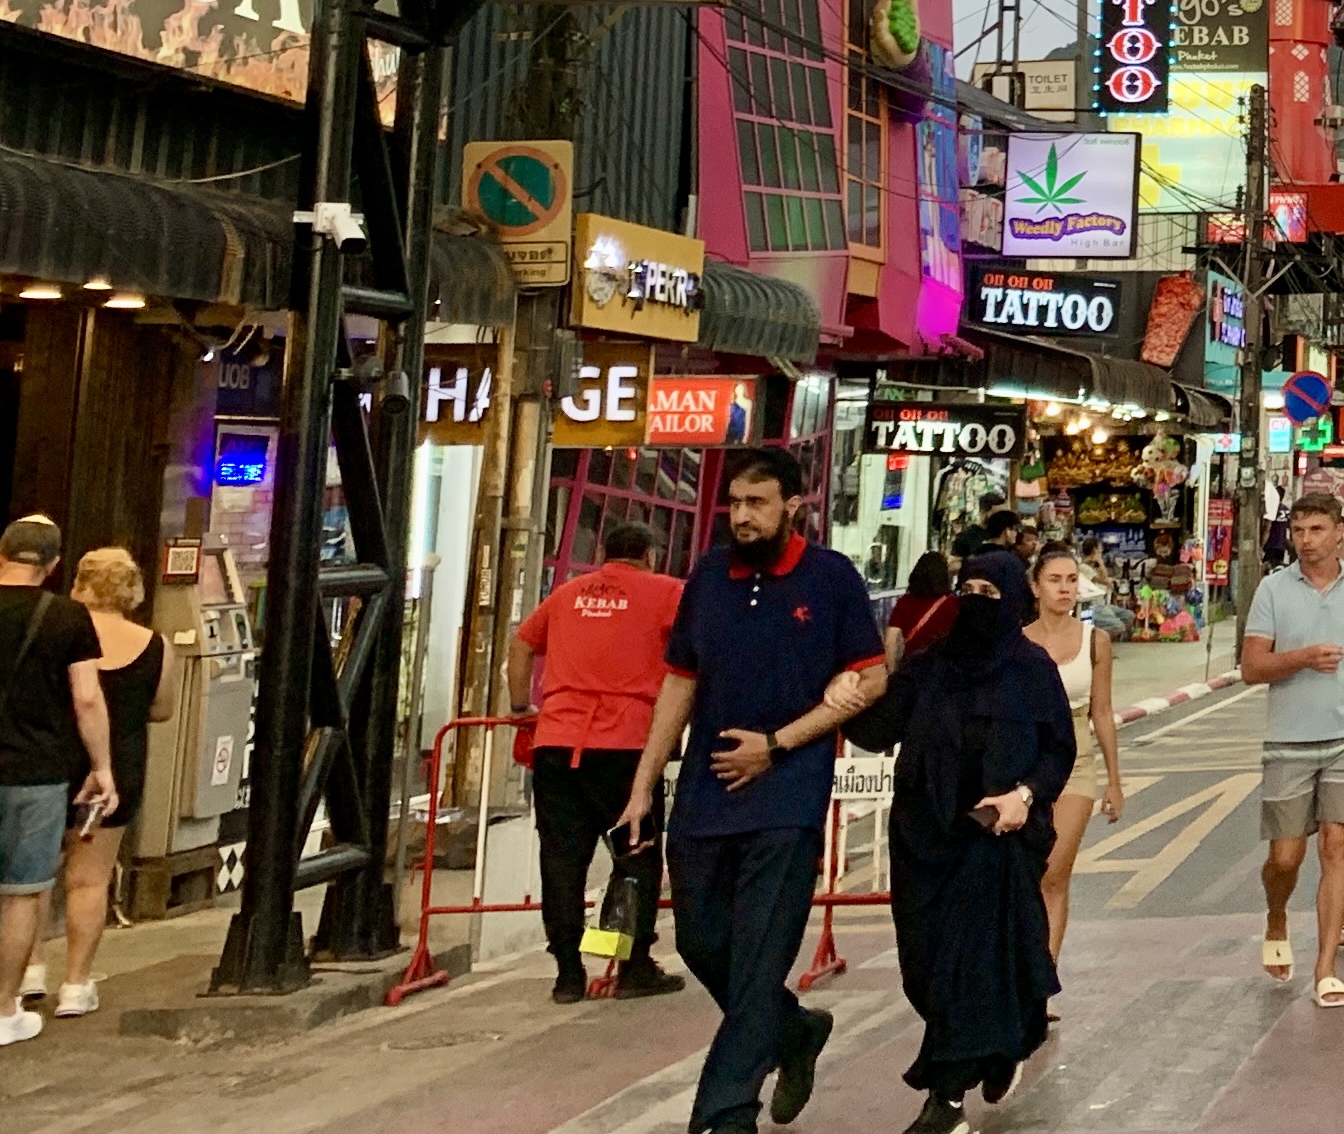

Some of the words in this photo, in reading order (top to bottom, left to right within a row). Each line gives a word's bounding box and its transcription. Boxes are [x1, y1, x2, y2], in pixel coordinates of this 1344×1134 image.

[1029, 74, 1068, 84] TOILET
[1013, 217, 1063, 236] Weedly
[1066, 214, 1126, 233] Factory
[1070, 238, 1098, 248] High
[980, 287, 1114, 332] TATTOO
[219, 364, 250, 390] UOB
[648, 413, 714, 433] AILOR
[871, 420, 1016, 455] TATTOO
[574, 596, 628, 610] KEBAB
